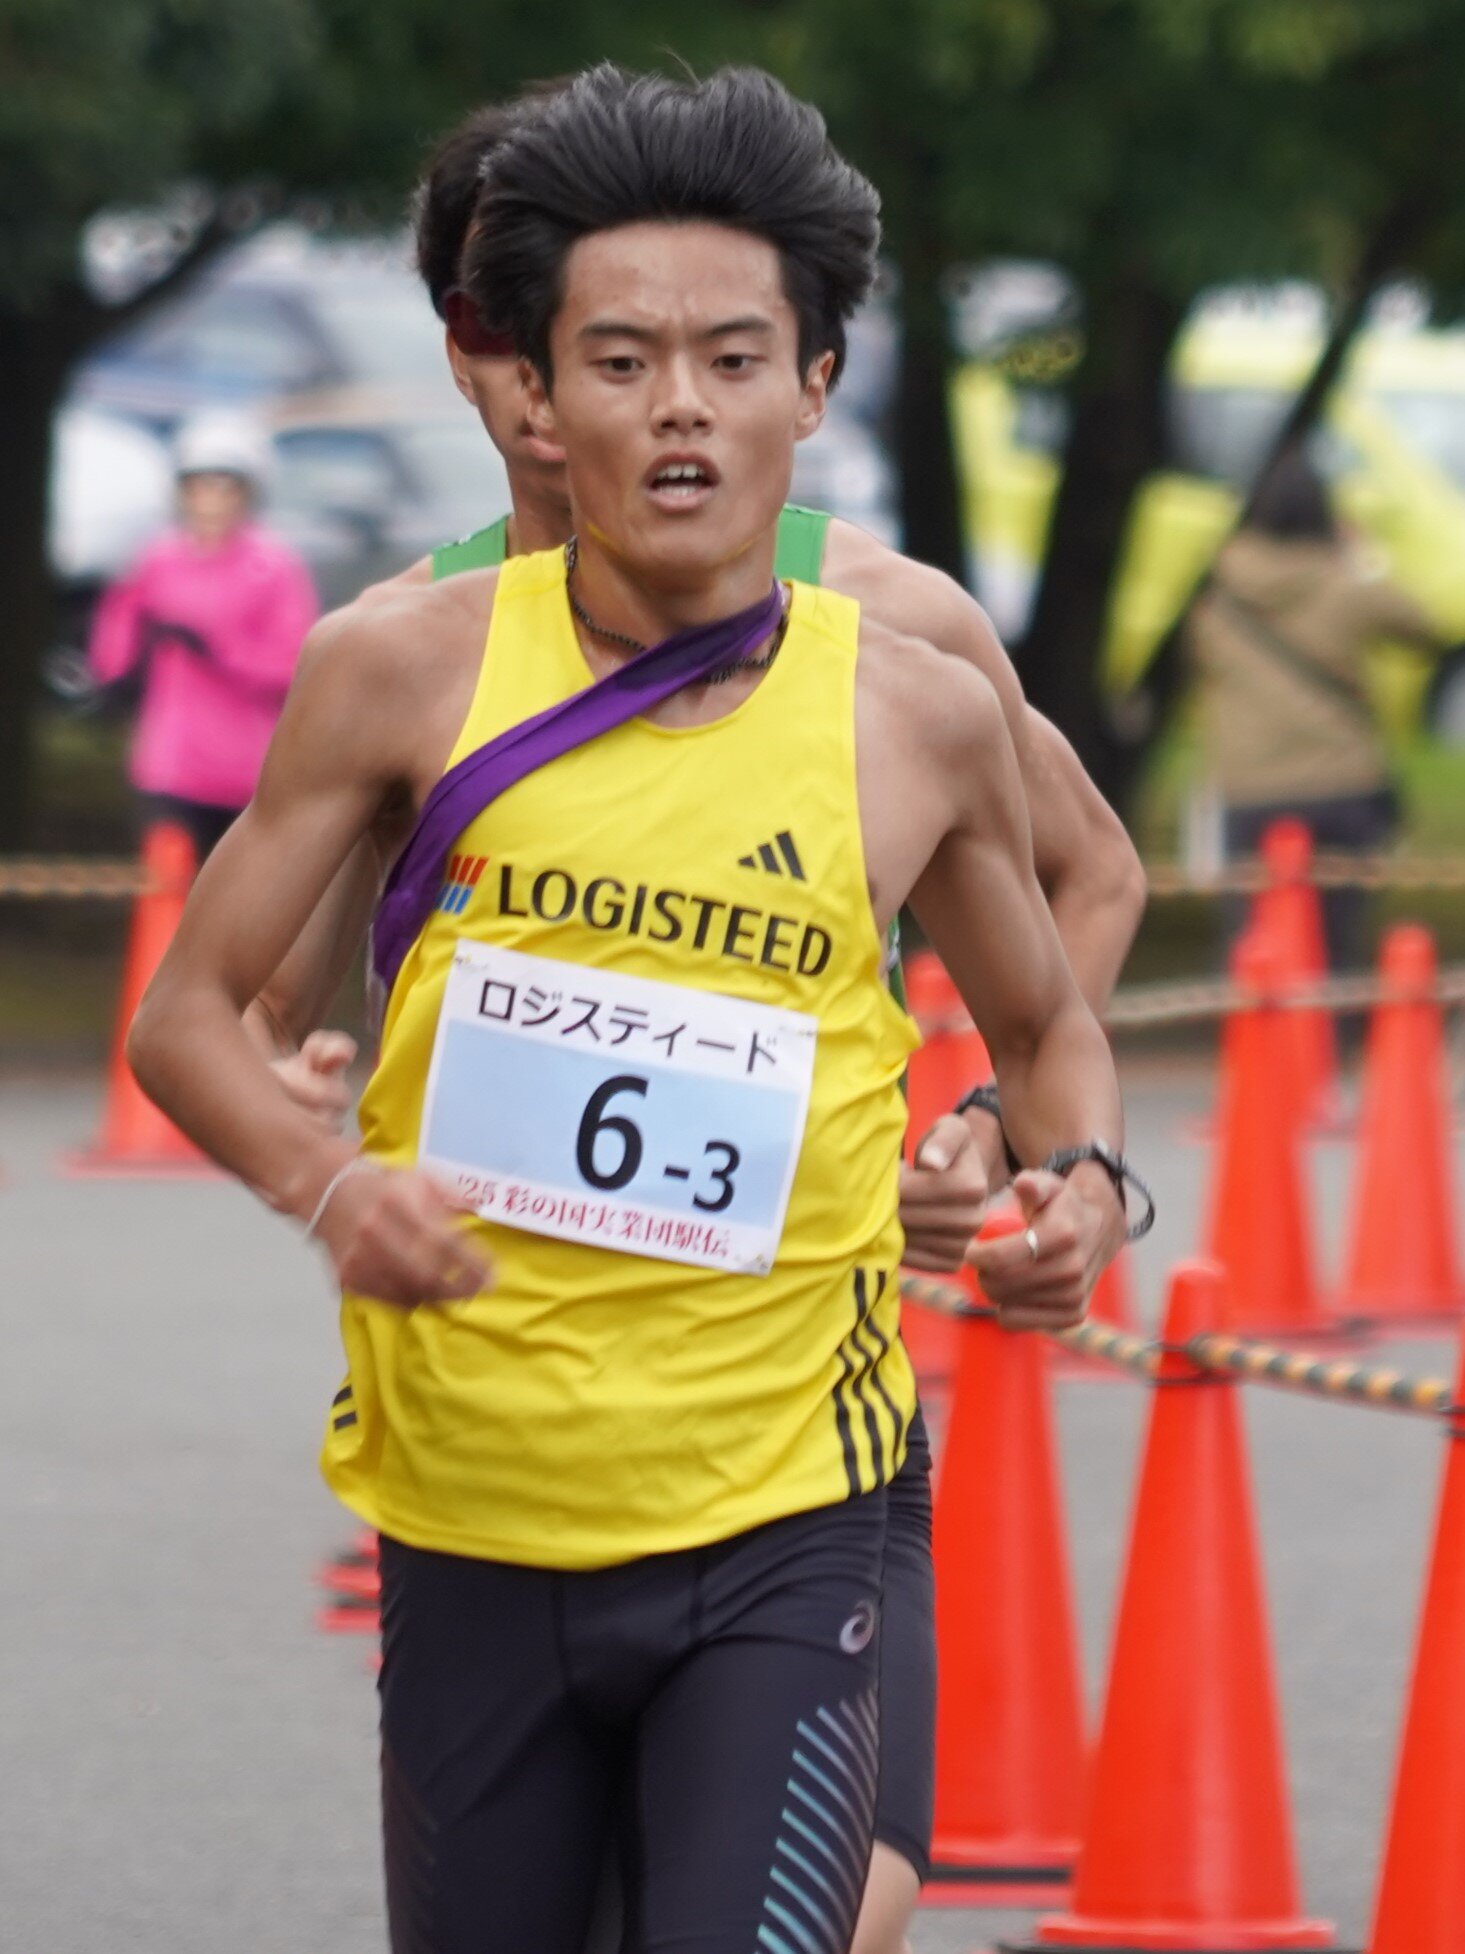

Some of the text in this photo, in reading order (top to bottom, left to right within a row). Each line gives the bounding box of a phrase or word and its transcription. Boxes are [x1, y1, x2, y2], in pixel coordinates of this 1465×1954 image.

[499, 865, 832, 977] LOGISTEED
[478, 979, 777, 1073] ロジスティード
